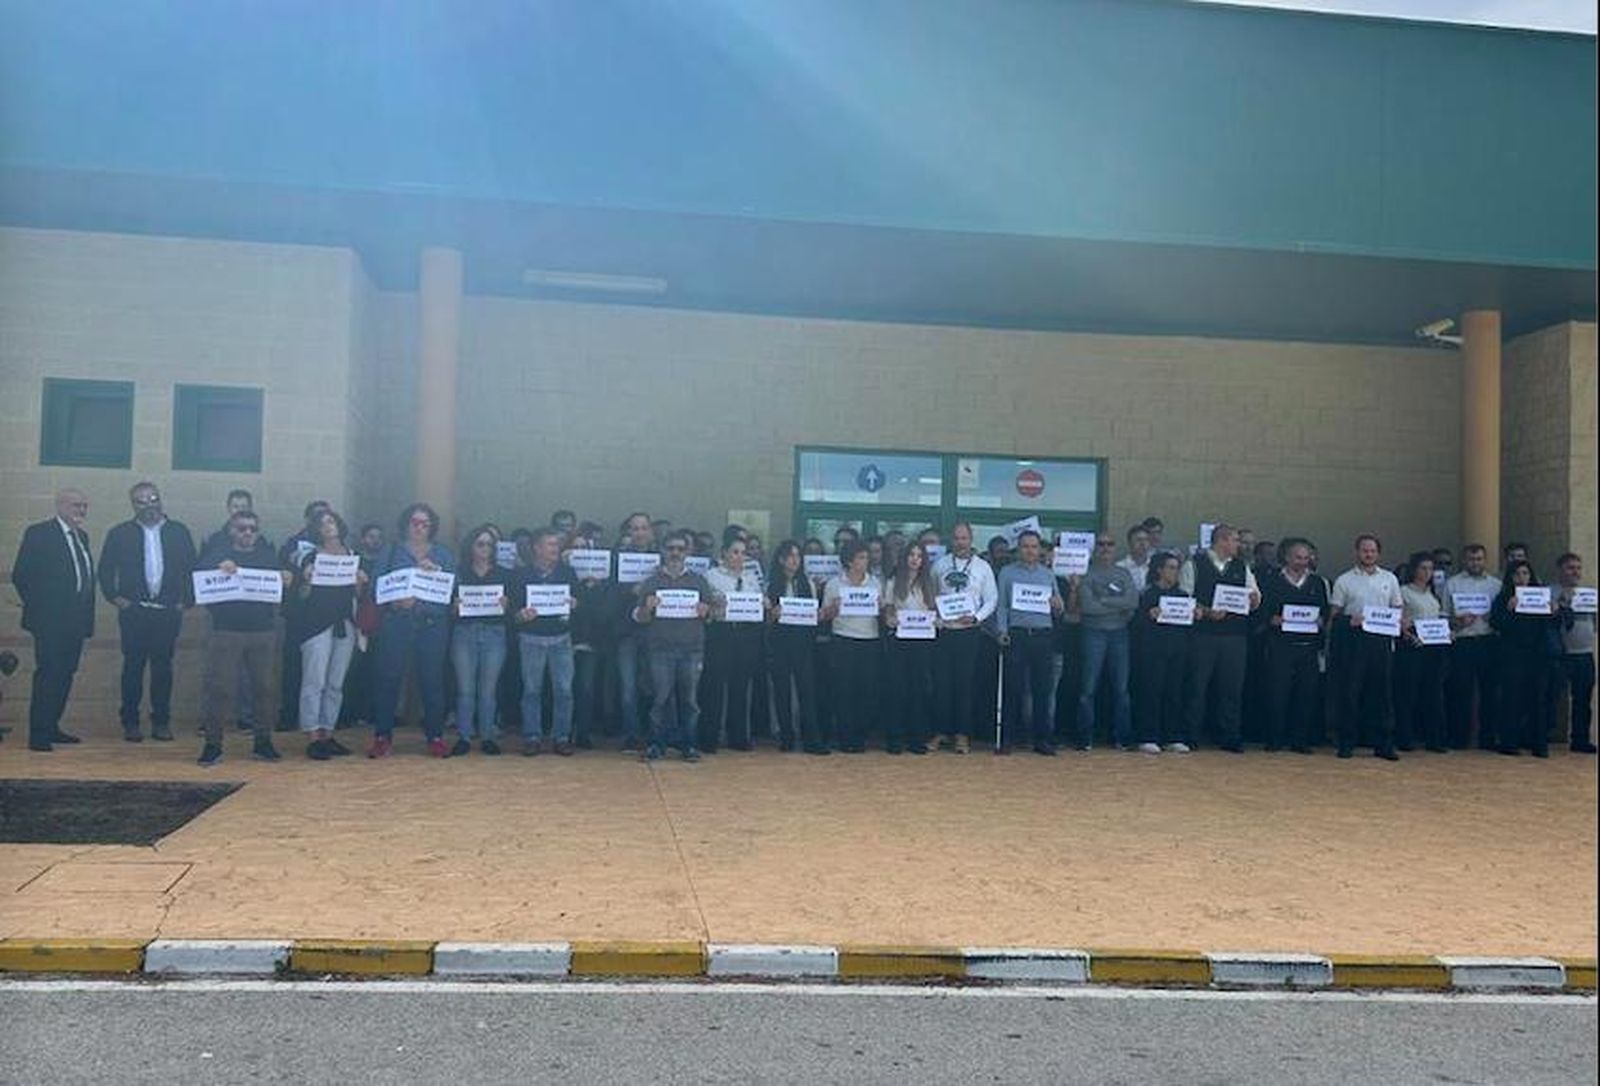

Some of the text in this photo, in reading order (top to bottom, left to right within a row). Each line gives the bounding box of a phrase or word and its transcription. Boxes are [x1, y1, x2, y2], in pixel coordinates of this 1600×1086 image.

[205, 575, 232, 585] STOP
[849, 592, 870, 601] STOP
[1021, 590, 1043, 598] STOP
